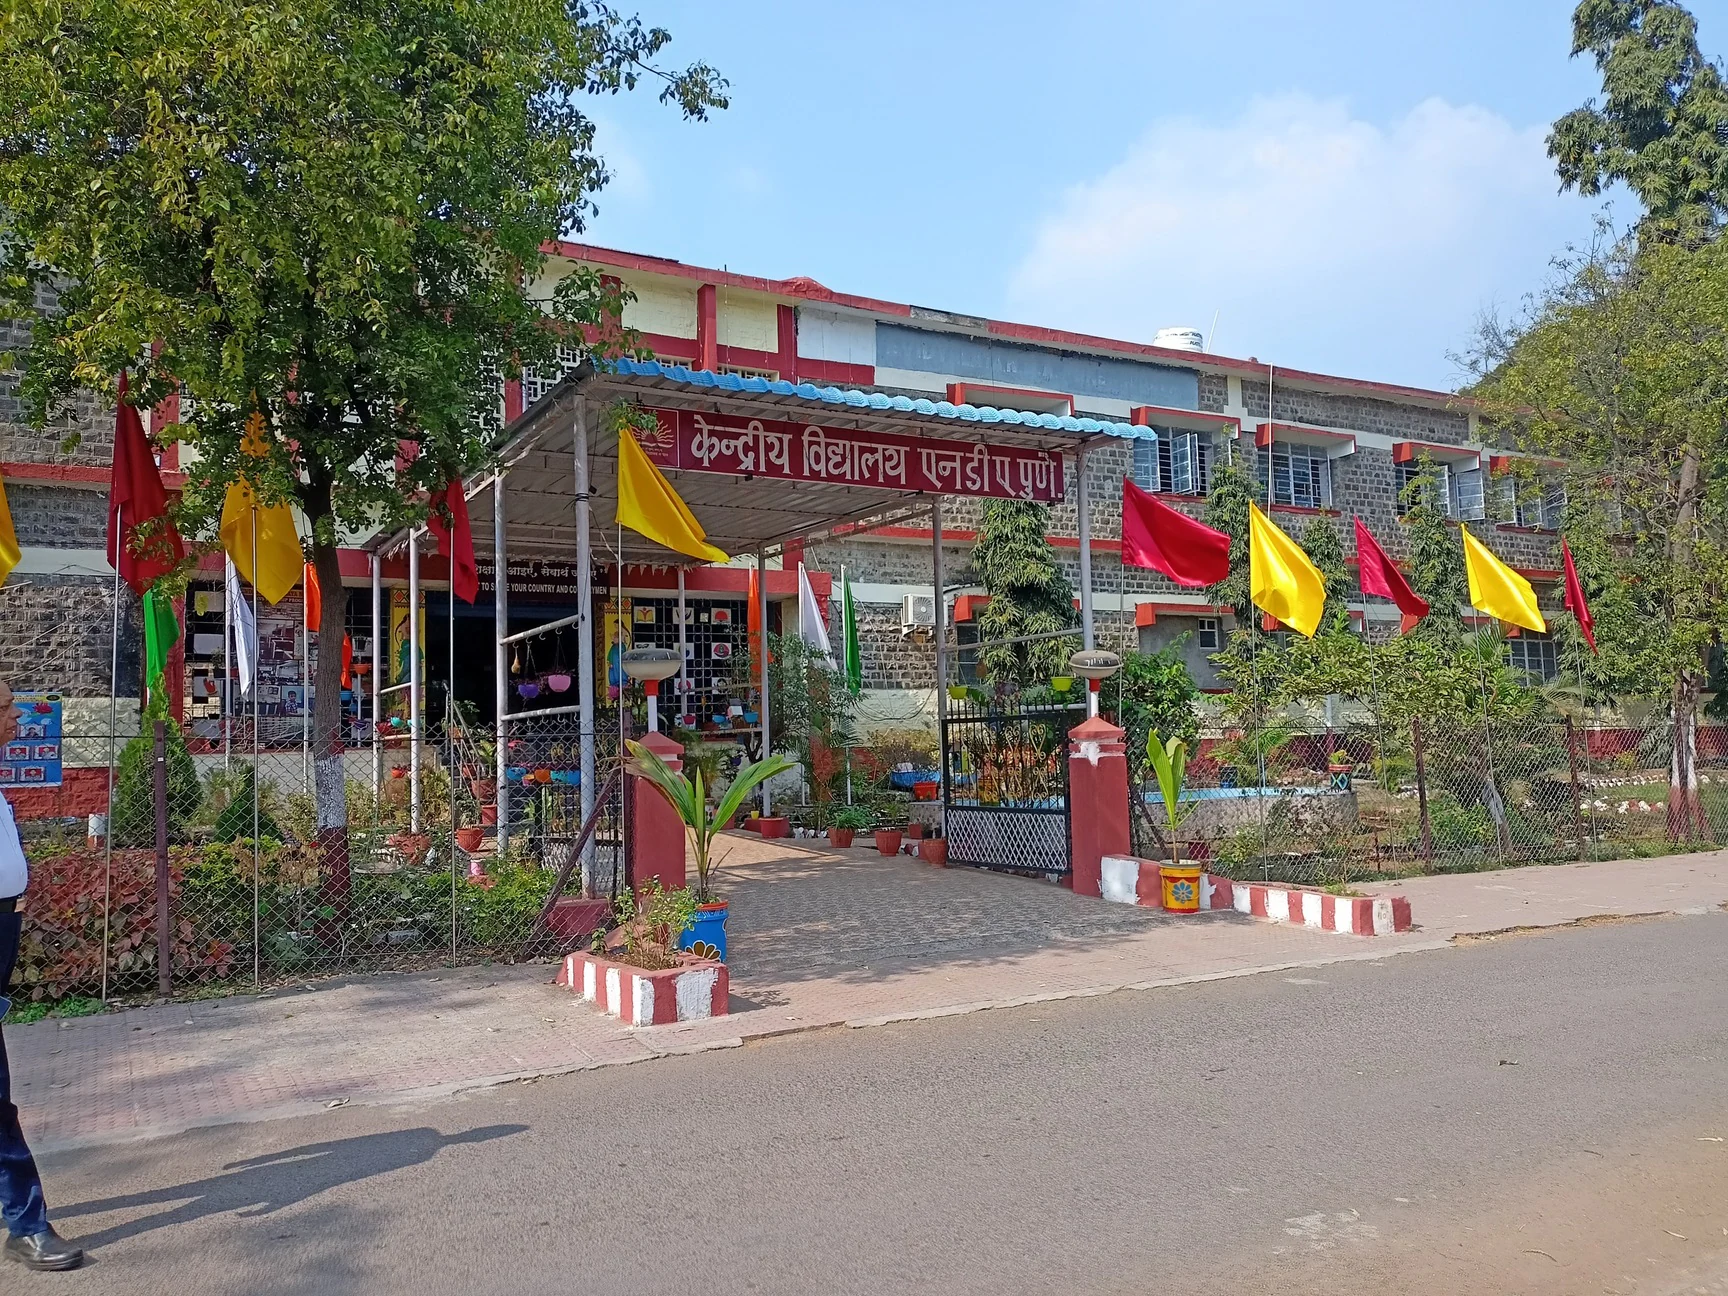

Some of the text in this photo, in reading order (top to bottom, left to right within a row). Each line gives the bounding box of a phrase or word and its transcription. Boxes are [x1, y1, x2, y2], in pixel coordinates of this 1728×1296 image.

[691, 414, 793, 475] केन्द्रीय
[801, 425, 910, 485] विद्यालय
[481, 582, 490, 591] TO
[510, 583, 527, 592] YOUR
[527, 583, 556, 593] COUNTRY
[555, 584, 569, 594] AND
[568, 585, 608, 595] COYMEN
